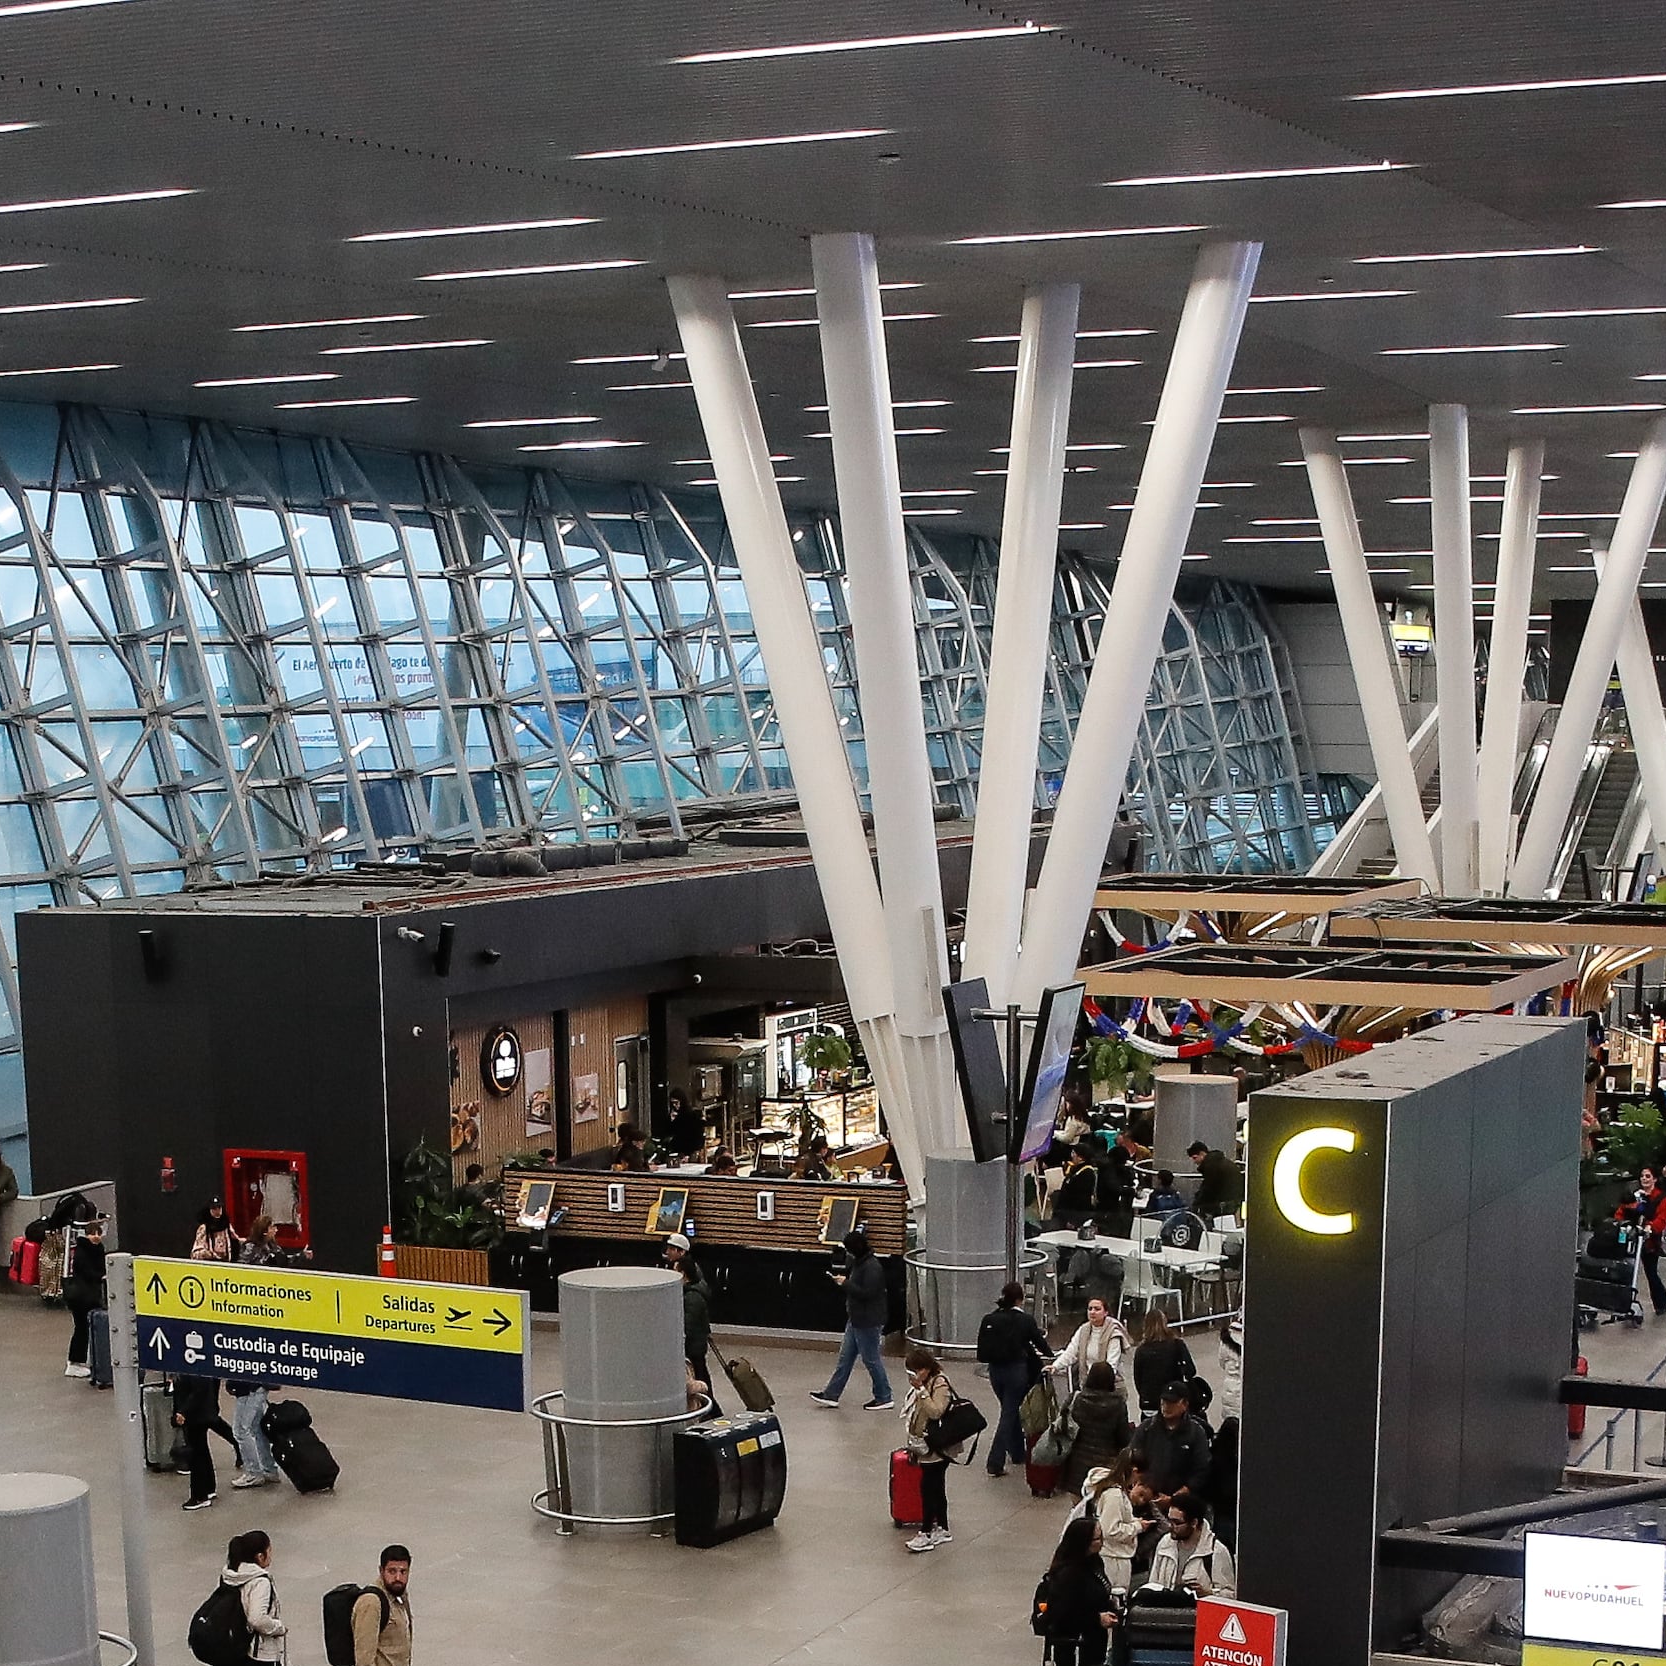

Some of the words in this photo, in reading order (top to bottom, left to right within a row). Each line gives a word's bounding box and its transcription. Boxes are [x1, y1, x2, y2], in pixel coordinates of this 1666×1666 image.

[1271, 1126, 1359, 1236] C
[210, 1278, 312, 1302] Informaciones
[211, 1299, 285, 1319] Information
[382, 1294, 436, 1314] Salidas
[365, 1314, 437, 1334] Departures
[213, 1332, 276, 1355] Custodia
[279, 1339, 299, 1357] de
[301, 1342, 366, 1367] Equipaje
[213, 1354, 268, 1376] Baggage
[269, 1361, 319, 1381] Storage
[1544, 1588, 1644, 1607] NUEVOPUDAHUEL
